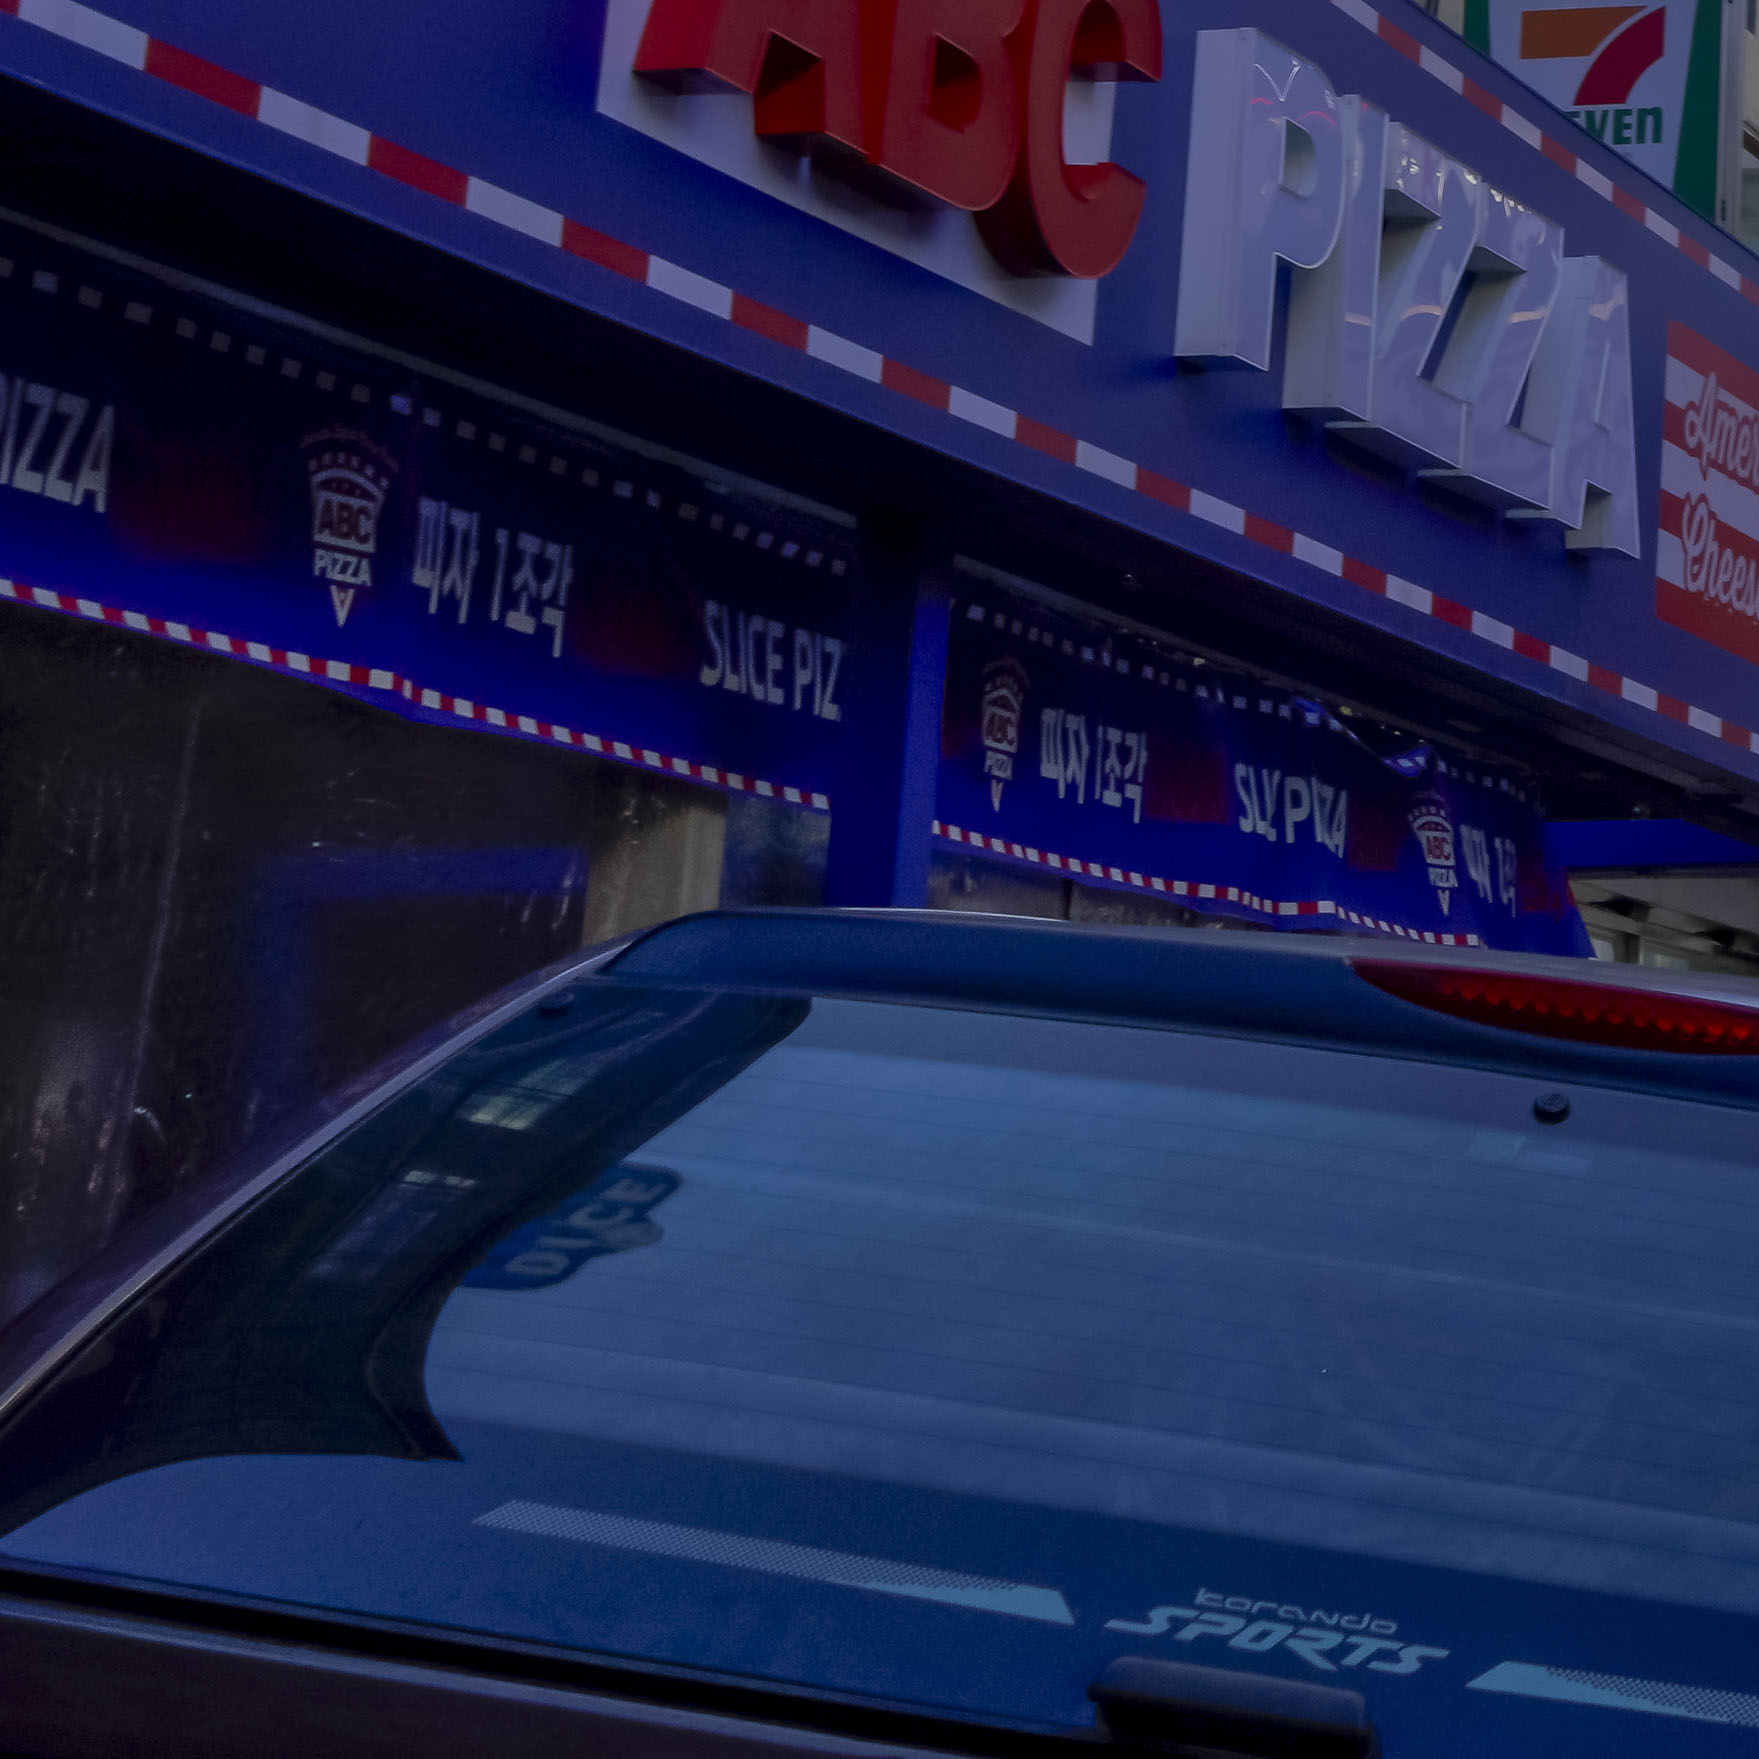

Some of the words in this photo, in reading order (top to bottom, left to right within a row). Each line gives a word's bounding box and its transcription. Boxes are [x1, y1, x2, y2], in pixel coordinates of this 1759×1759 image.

[1174, 27, 1641, 560] PIZZA
[314, 488, 376, 546] ABC
[412, 496, 482, 625] 피자
[311, 547, 373, 588] PIZZA
[700, 599, 786, 706] SLICE
[1103, 1605, 1451, 1675] SPORTS
